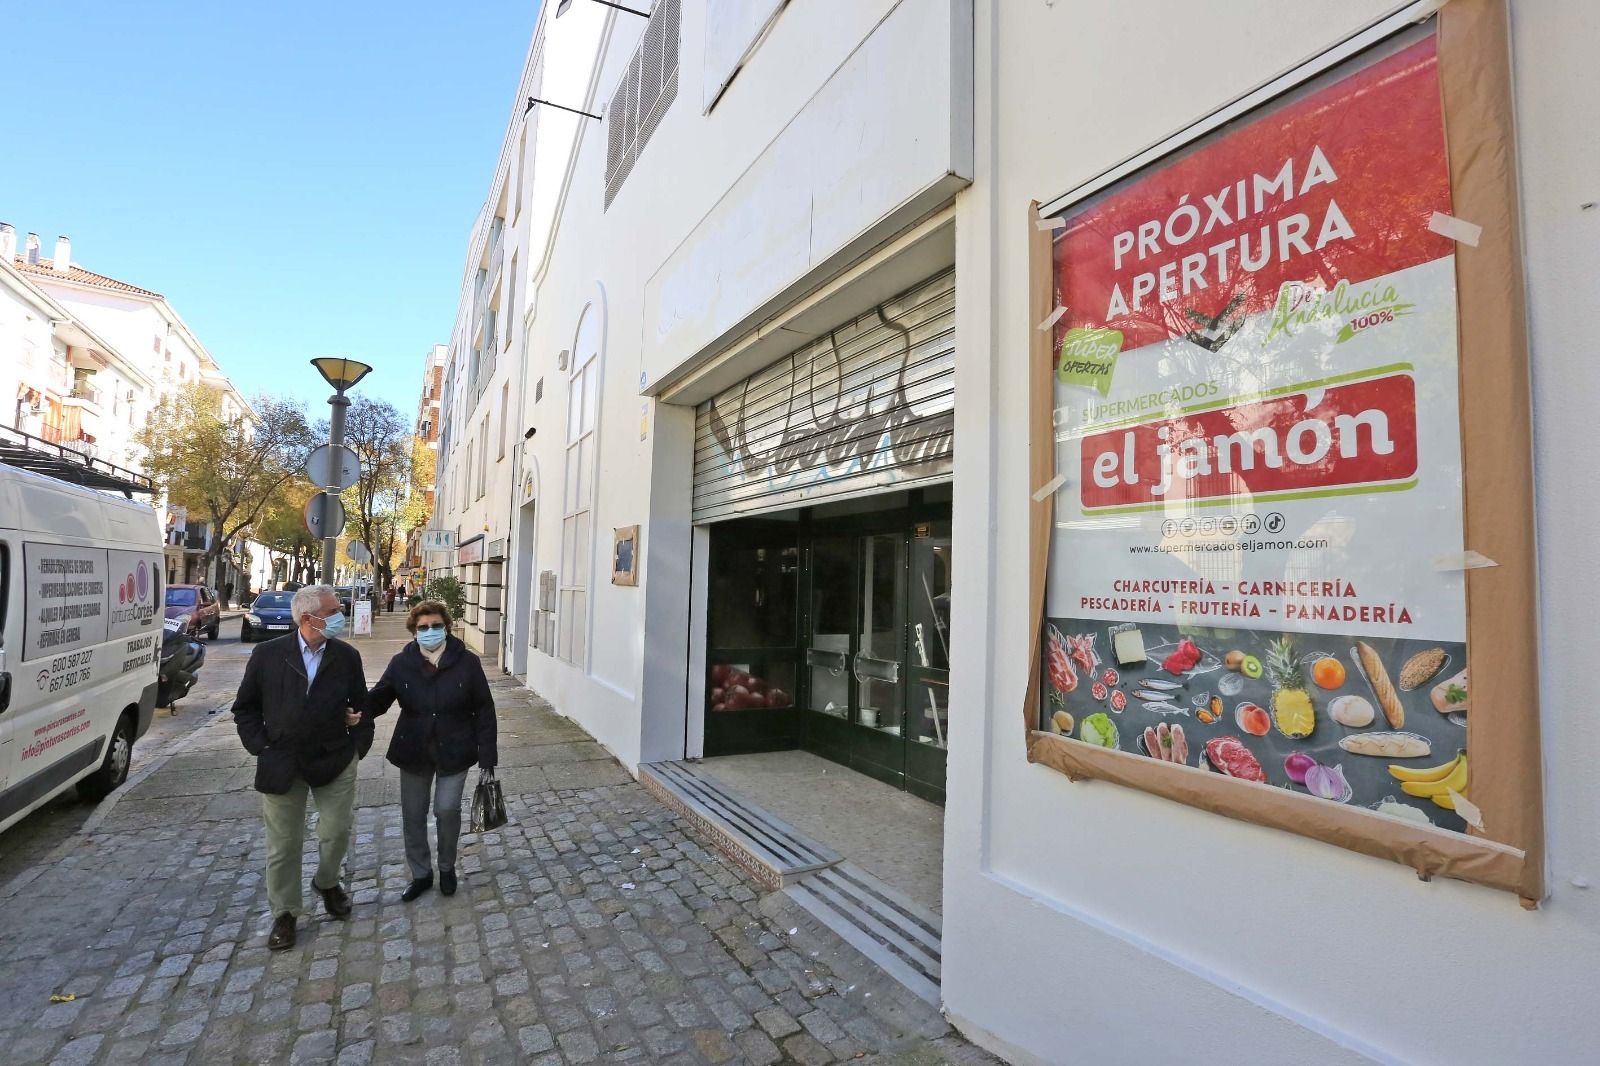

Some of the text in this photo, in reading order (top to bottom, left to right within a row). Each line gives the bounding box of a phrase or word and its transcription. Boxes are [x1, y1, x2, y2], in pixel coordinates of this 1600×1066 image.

[1113, 145, 1339, 270] PRÓXIMA
[1105, 198, 1356, 321] APERTURA
[1350, 310, 1394, 331] 100%
[1066, 340, 1118, 360] SUPER
[1081, 380, 1219, 423] SUPERMERCADOS
[1092, 388, 1395, 496] el jamón
[1129, 537, 1328, 555] www.supermercadoseljamon.com
[1113, 578, 1216, 595] CHARCUTERÍA
[1238, 579, 1357, 598] CARNICERÍA
[1080, 596, 1163, 613] PESCADERÍA
[1181, 599, 1261, 618] FRUTERÍA
[1286, 603, 1413, 625] PANADERÍA
[126, 636, 153, 654] TRABAJOS
[52, 650, 93, 673] 600 587 227
[122, 653, 152, 673] VERTICALES
[49, 676, 64, 693] 667
[65, 671, 77, 687] 501
